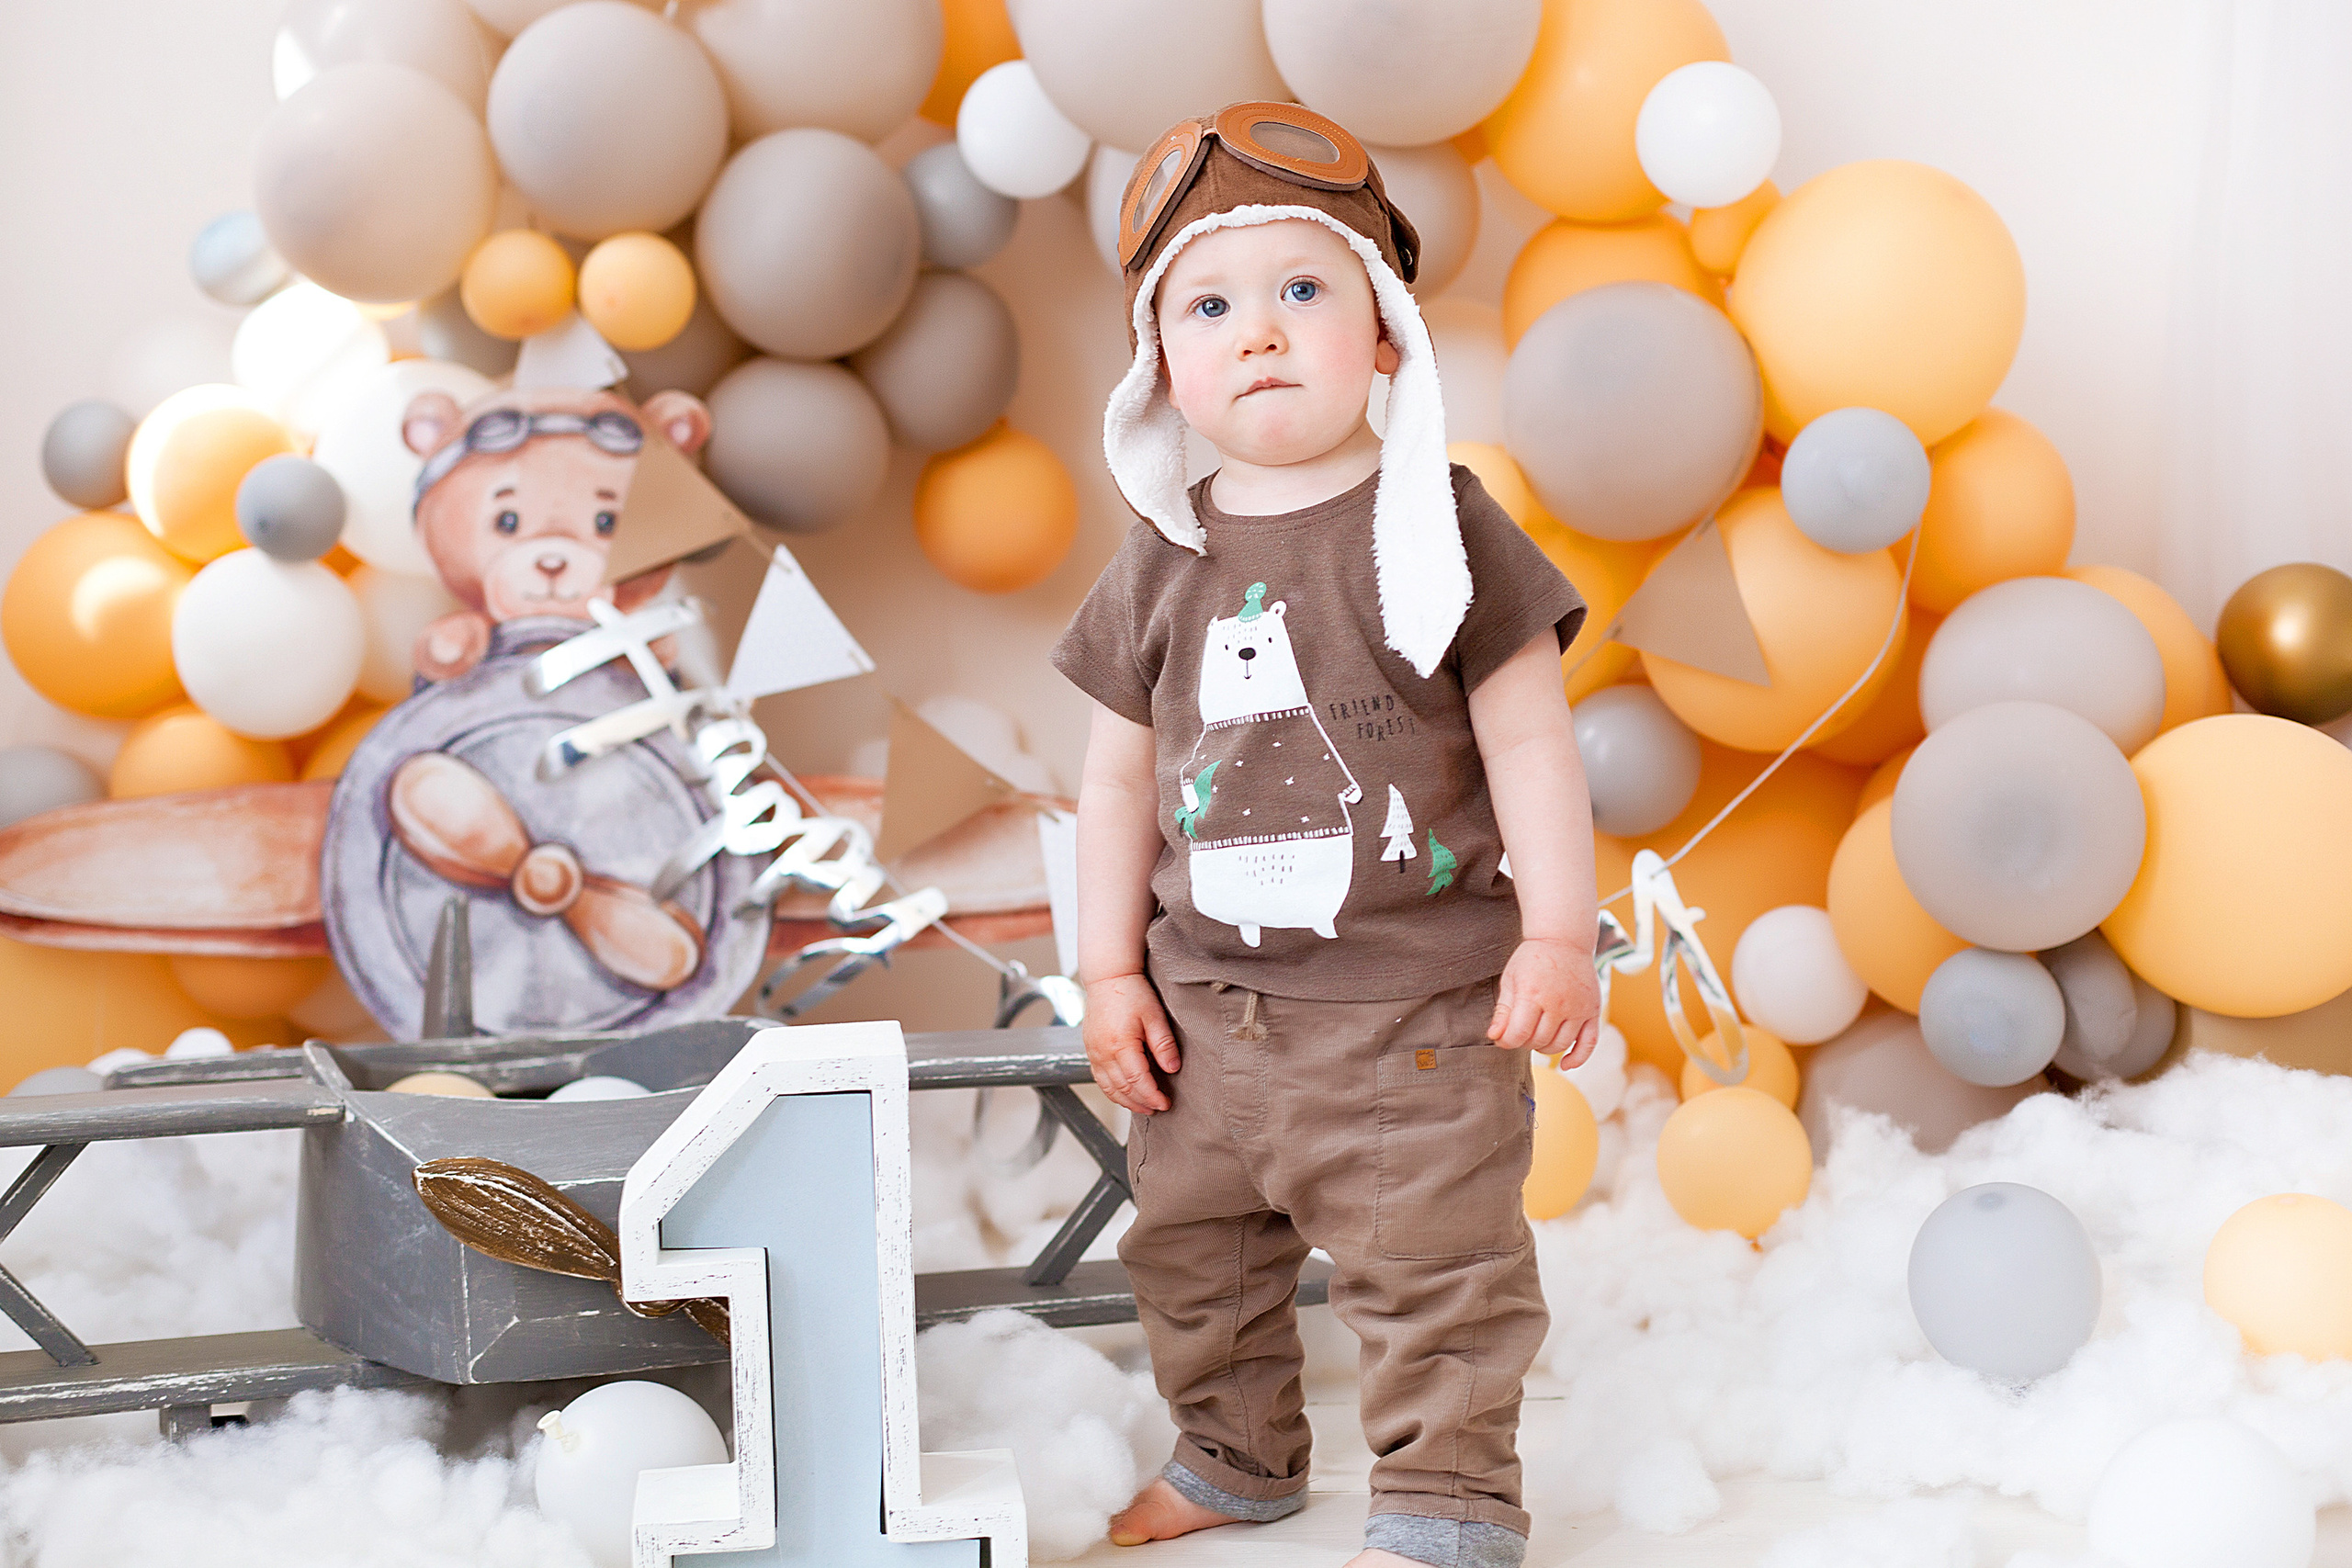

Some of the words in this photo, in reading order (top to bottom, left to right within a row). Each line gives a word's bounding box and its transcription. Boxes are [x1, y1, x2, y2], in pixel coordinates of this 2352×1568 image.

[1329, 694, 1395, 720] FRIEND
[1358, 716, 1415, 741] FOREST
[619, 1021, 1027, 1568] 1
